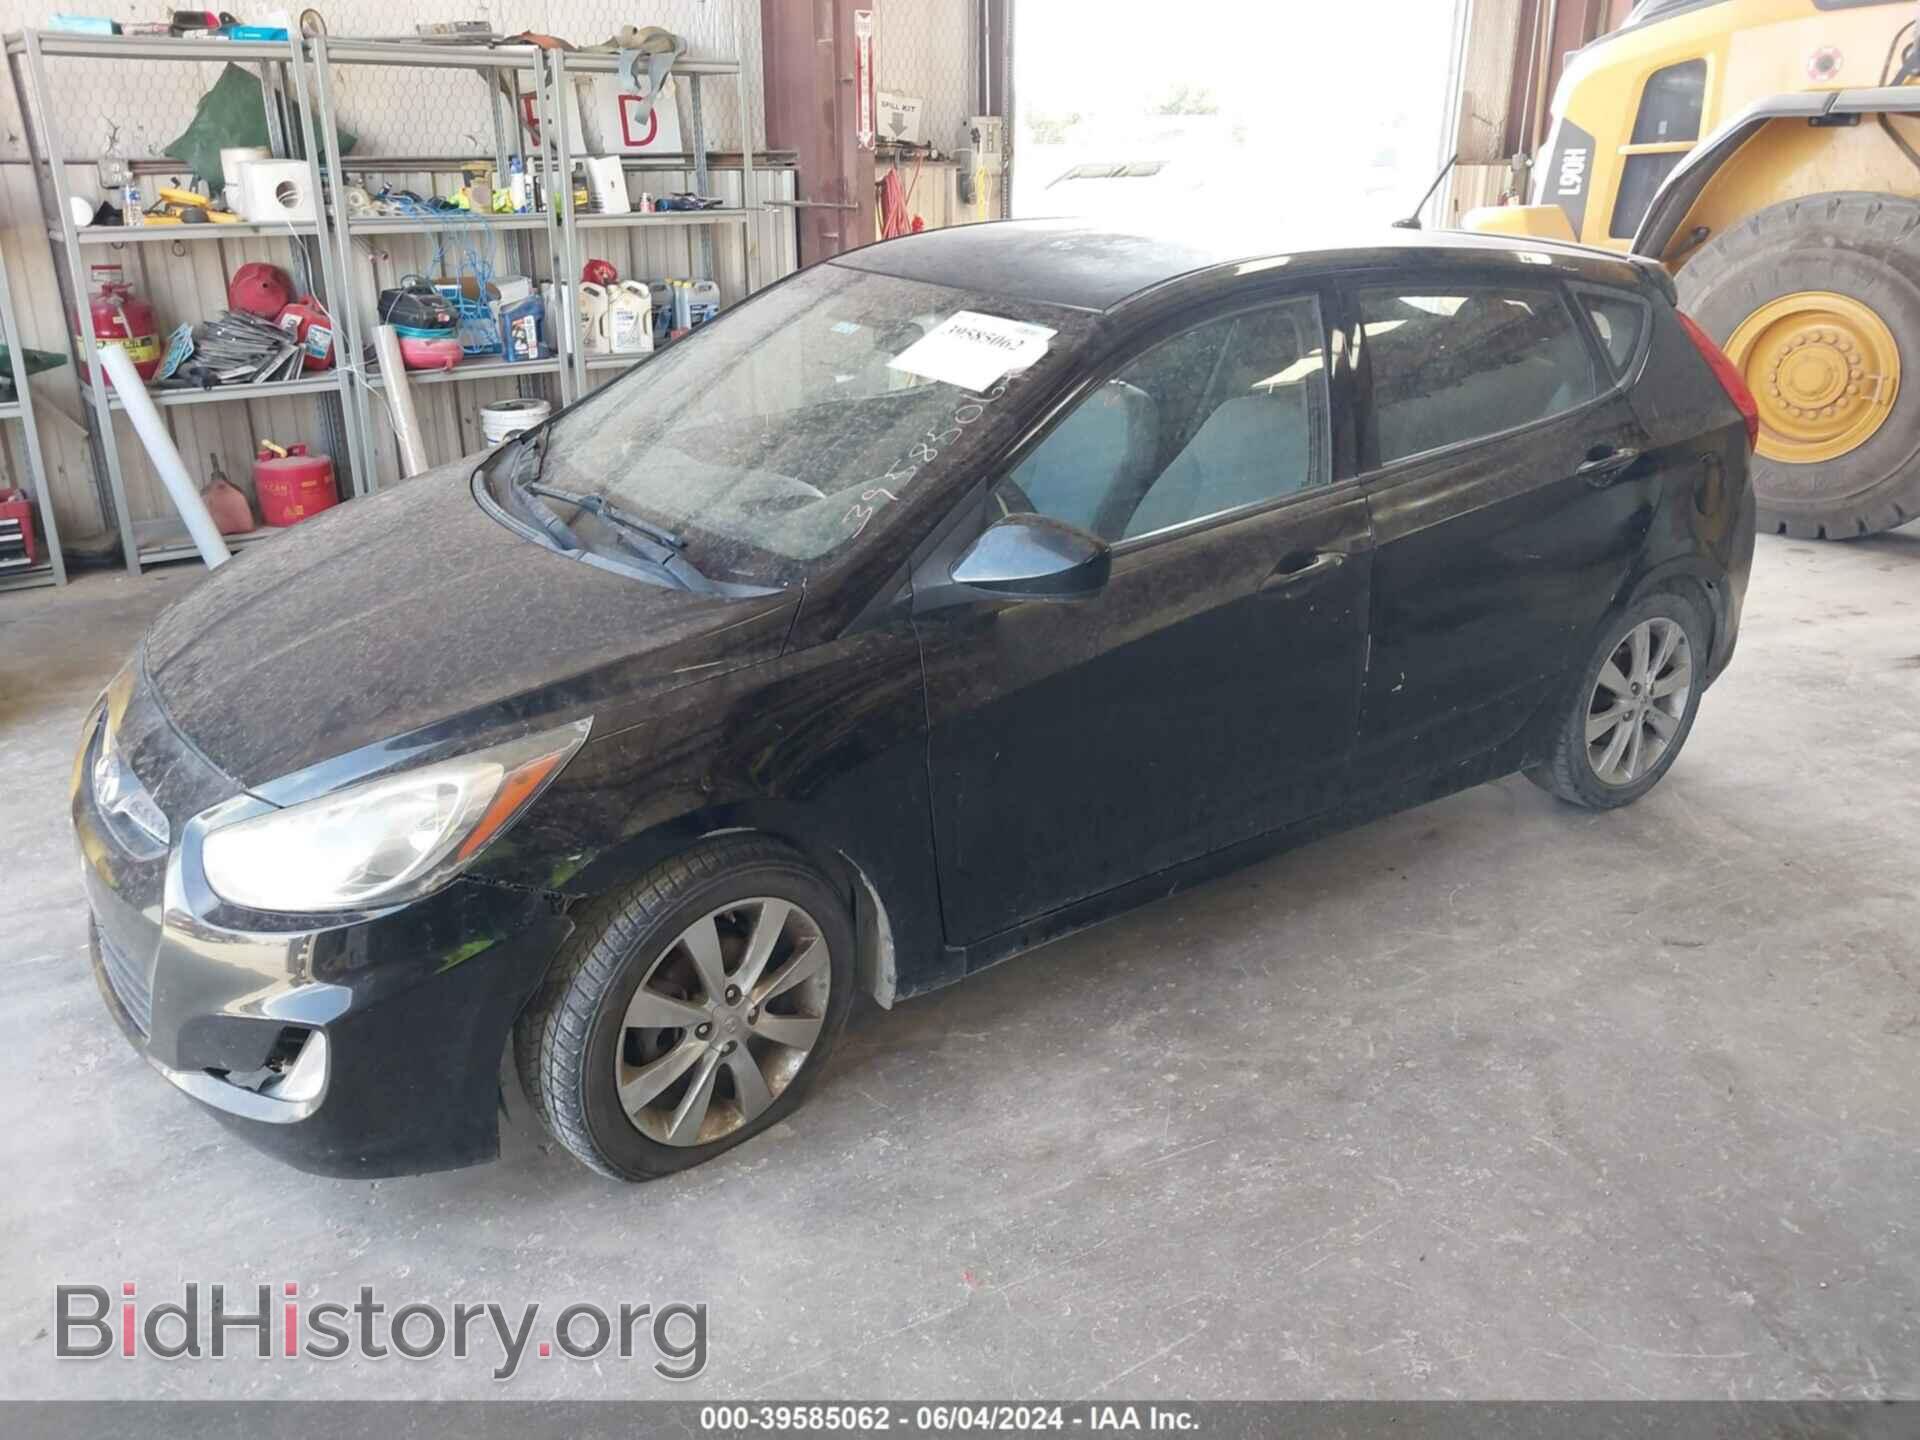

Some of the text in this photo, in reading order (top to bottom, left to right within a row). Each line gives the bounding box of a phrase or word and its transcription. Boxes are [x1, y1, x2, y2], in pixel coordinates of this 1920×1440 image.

[617, 94, 658, 147] D
[881, 101, 916, 112] SPILL KIT
